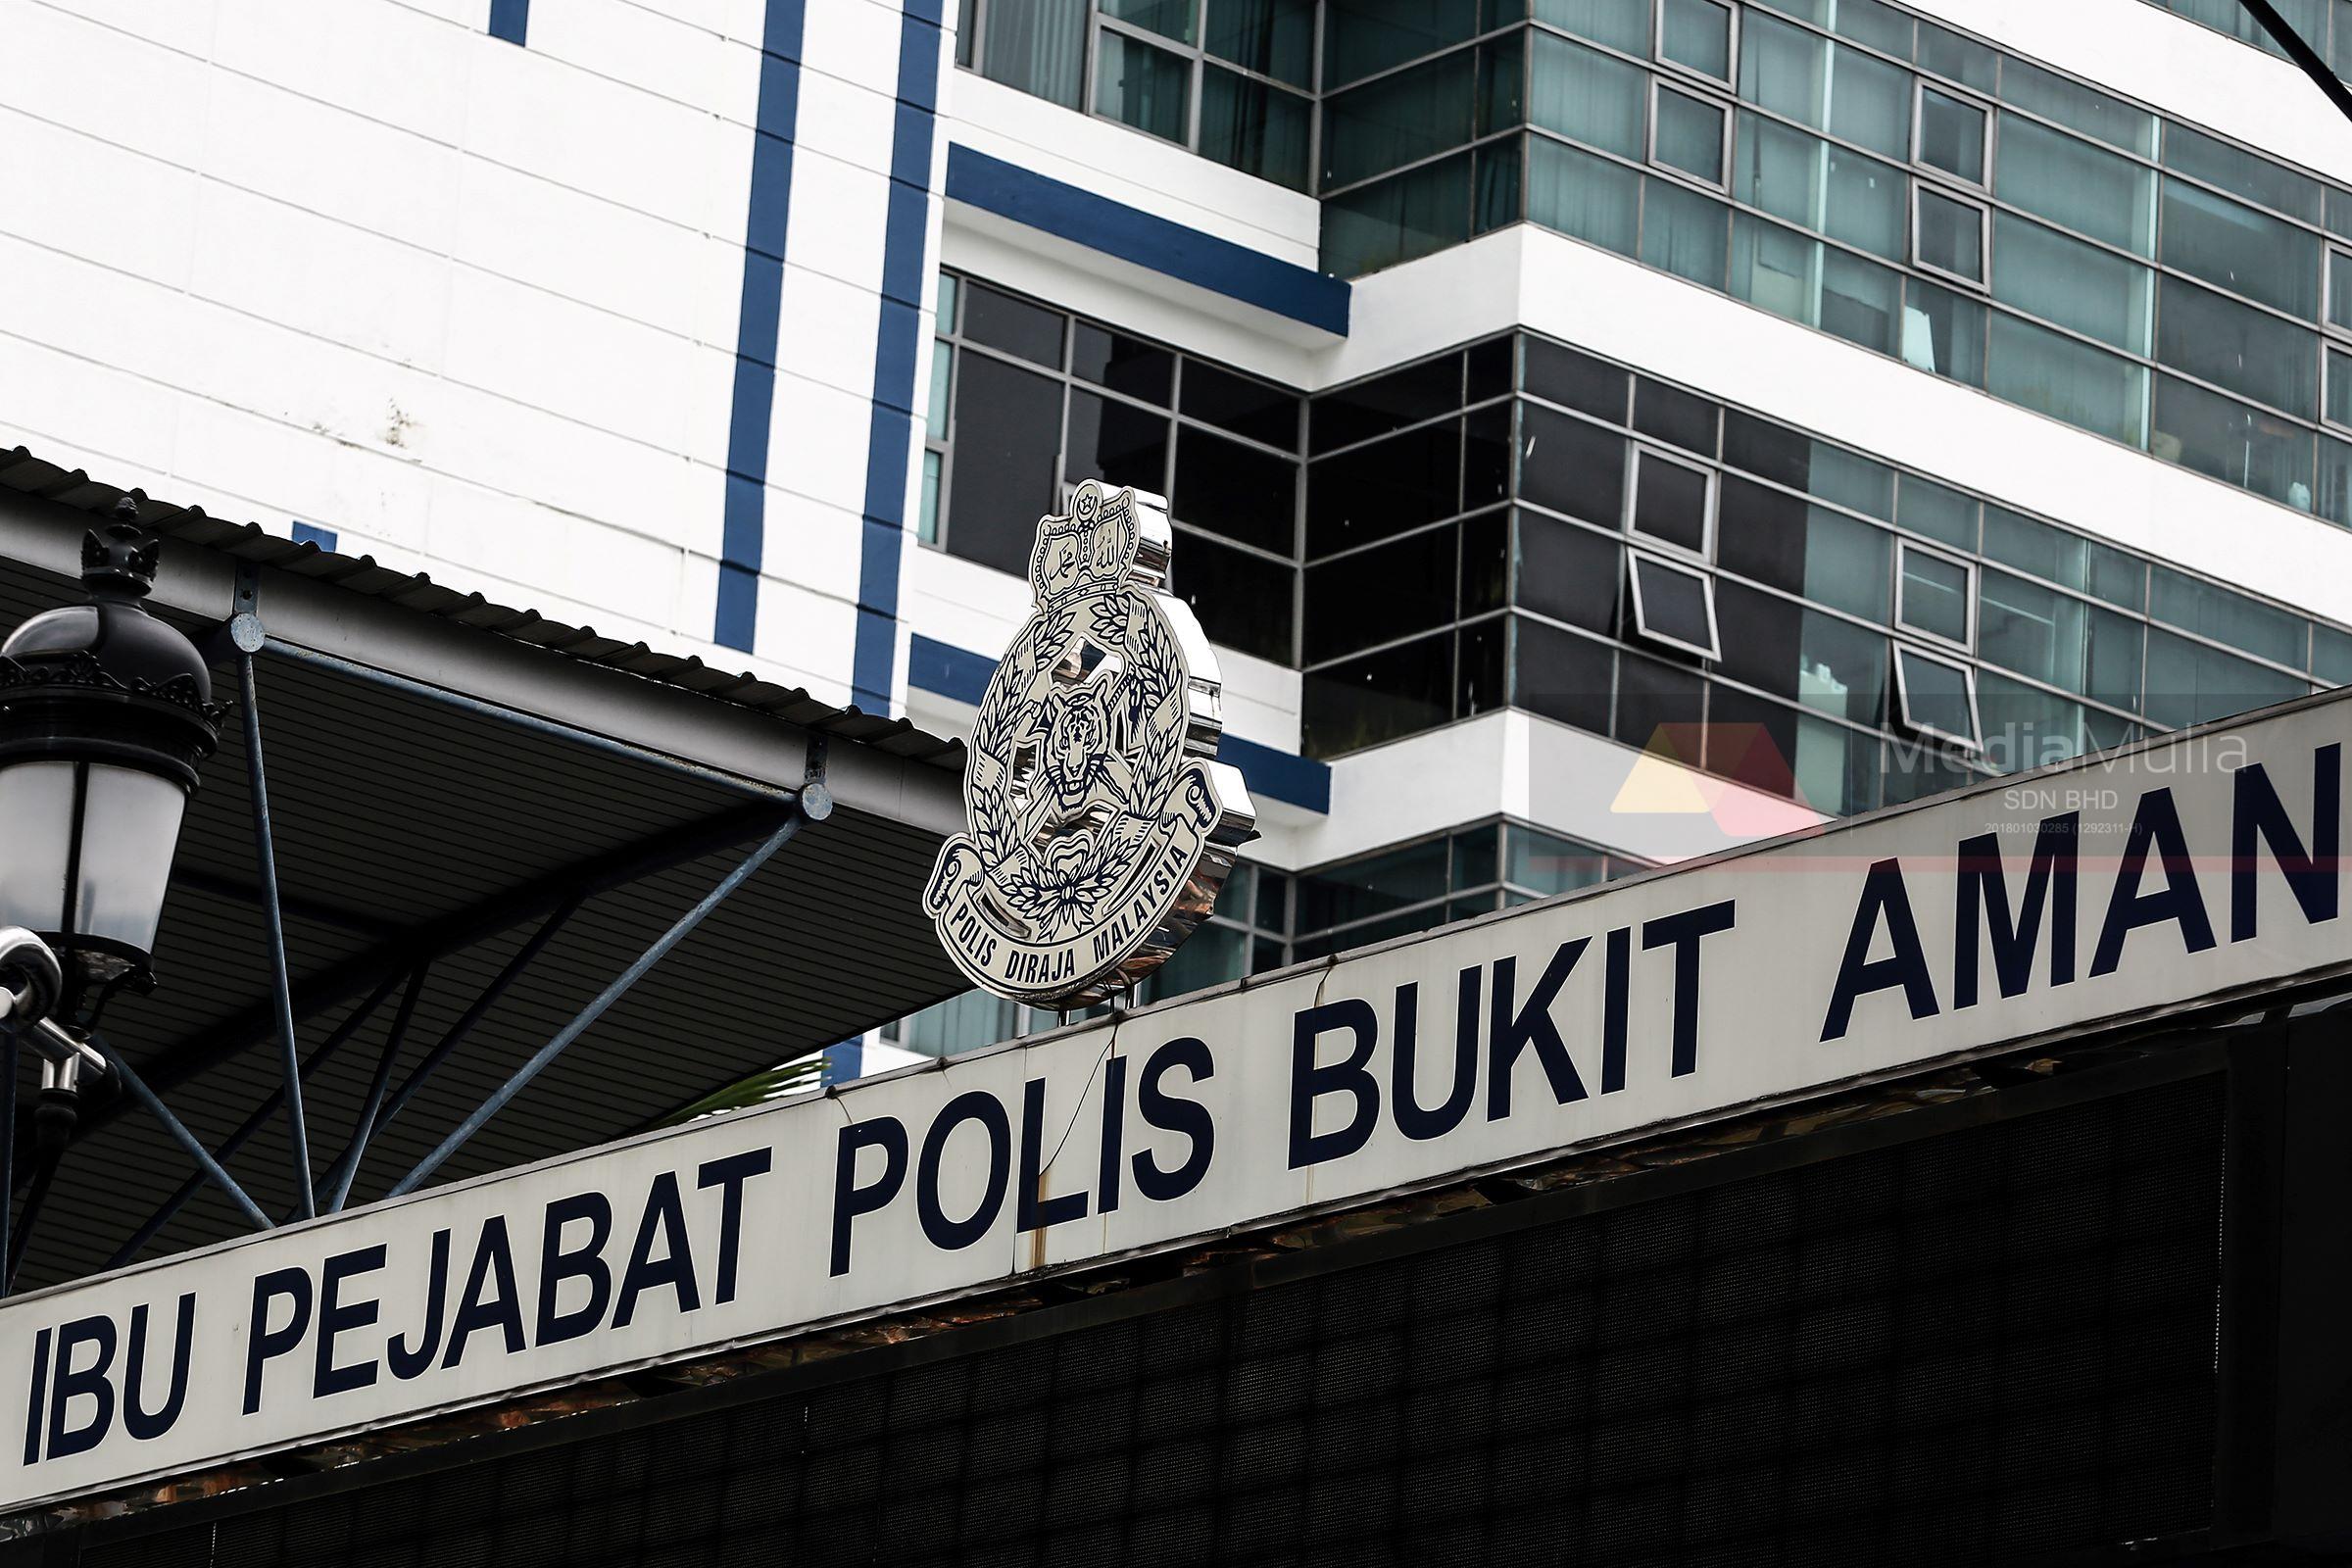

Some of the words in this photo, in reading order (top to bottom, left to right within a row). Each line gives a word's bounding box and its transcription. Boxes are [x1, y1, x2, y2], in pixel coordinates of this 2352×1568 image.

[24, 1292, 195, 1466] IBU
[243, 1146, 772, 1416] PEJABAT
[829, 1036, 1215, 1278] POLIS
[1287, 899, 1737, 1171] BUKIT
[1819, 742, 2341, 1043] AMAN
[950, 901, 998, 967] POLIS
[1004, 949, 1076, 983] DIRAJA
[1093, 845, 1189, 963] MALAYSIA
